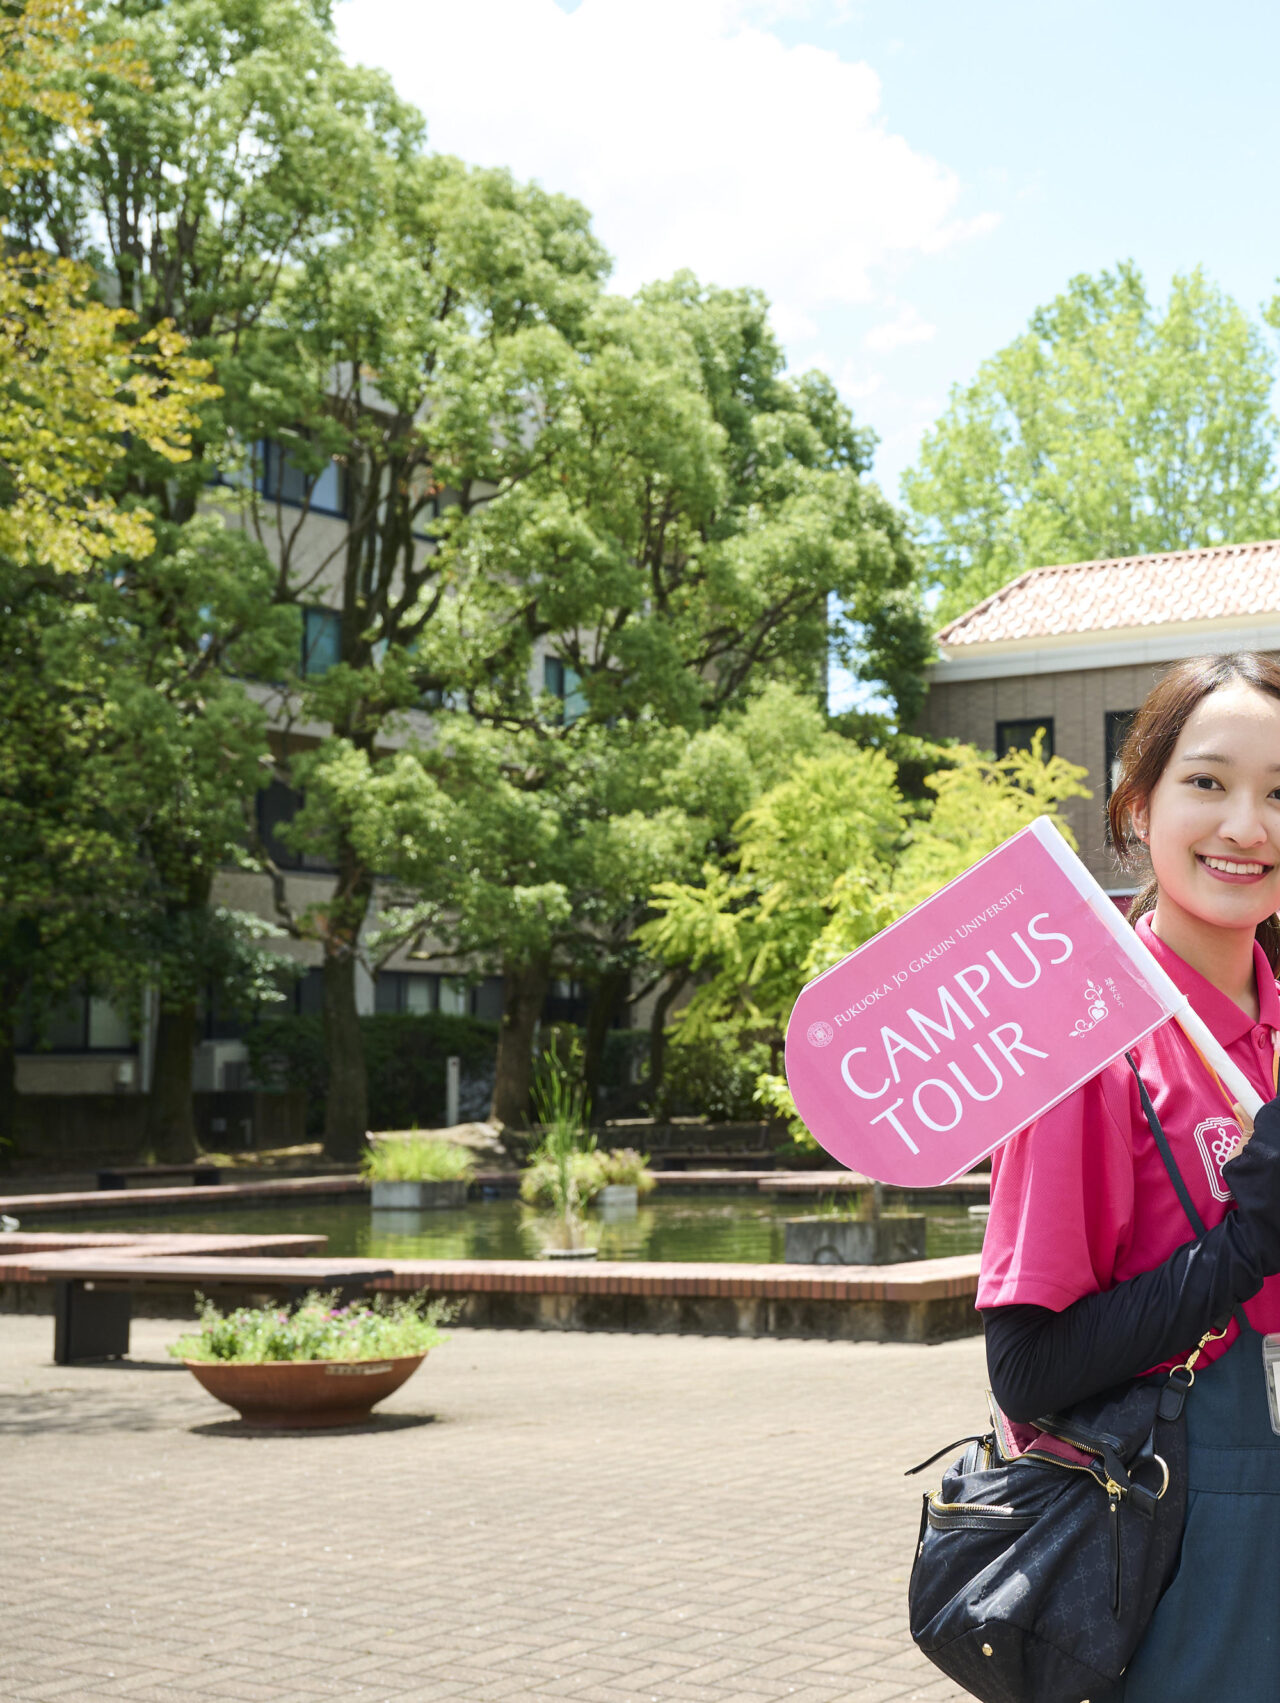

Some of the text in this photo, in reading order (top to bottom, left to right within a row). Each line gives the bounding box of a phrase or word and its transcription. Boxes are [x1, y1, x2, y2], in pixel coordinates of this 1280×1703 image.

[833, 884, 1025, 1028] FUKUOKA JO GAKUIN UNIVERSITY
[840, 912, 1074, 1100] CAMPUS
[869, 1021, 1049, 1155] TOUR
